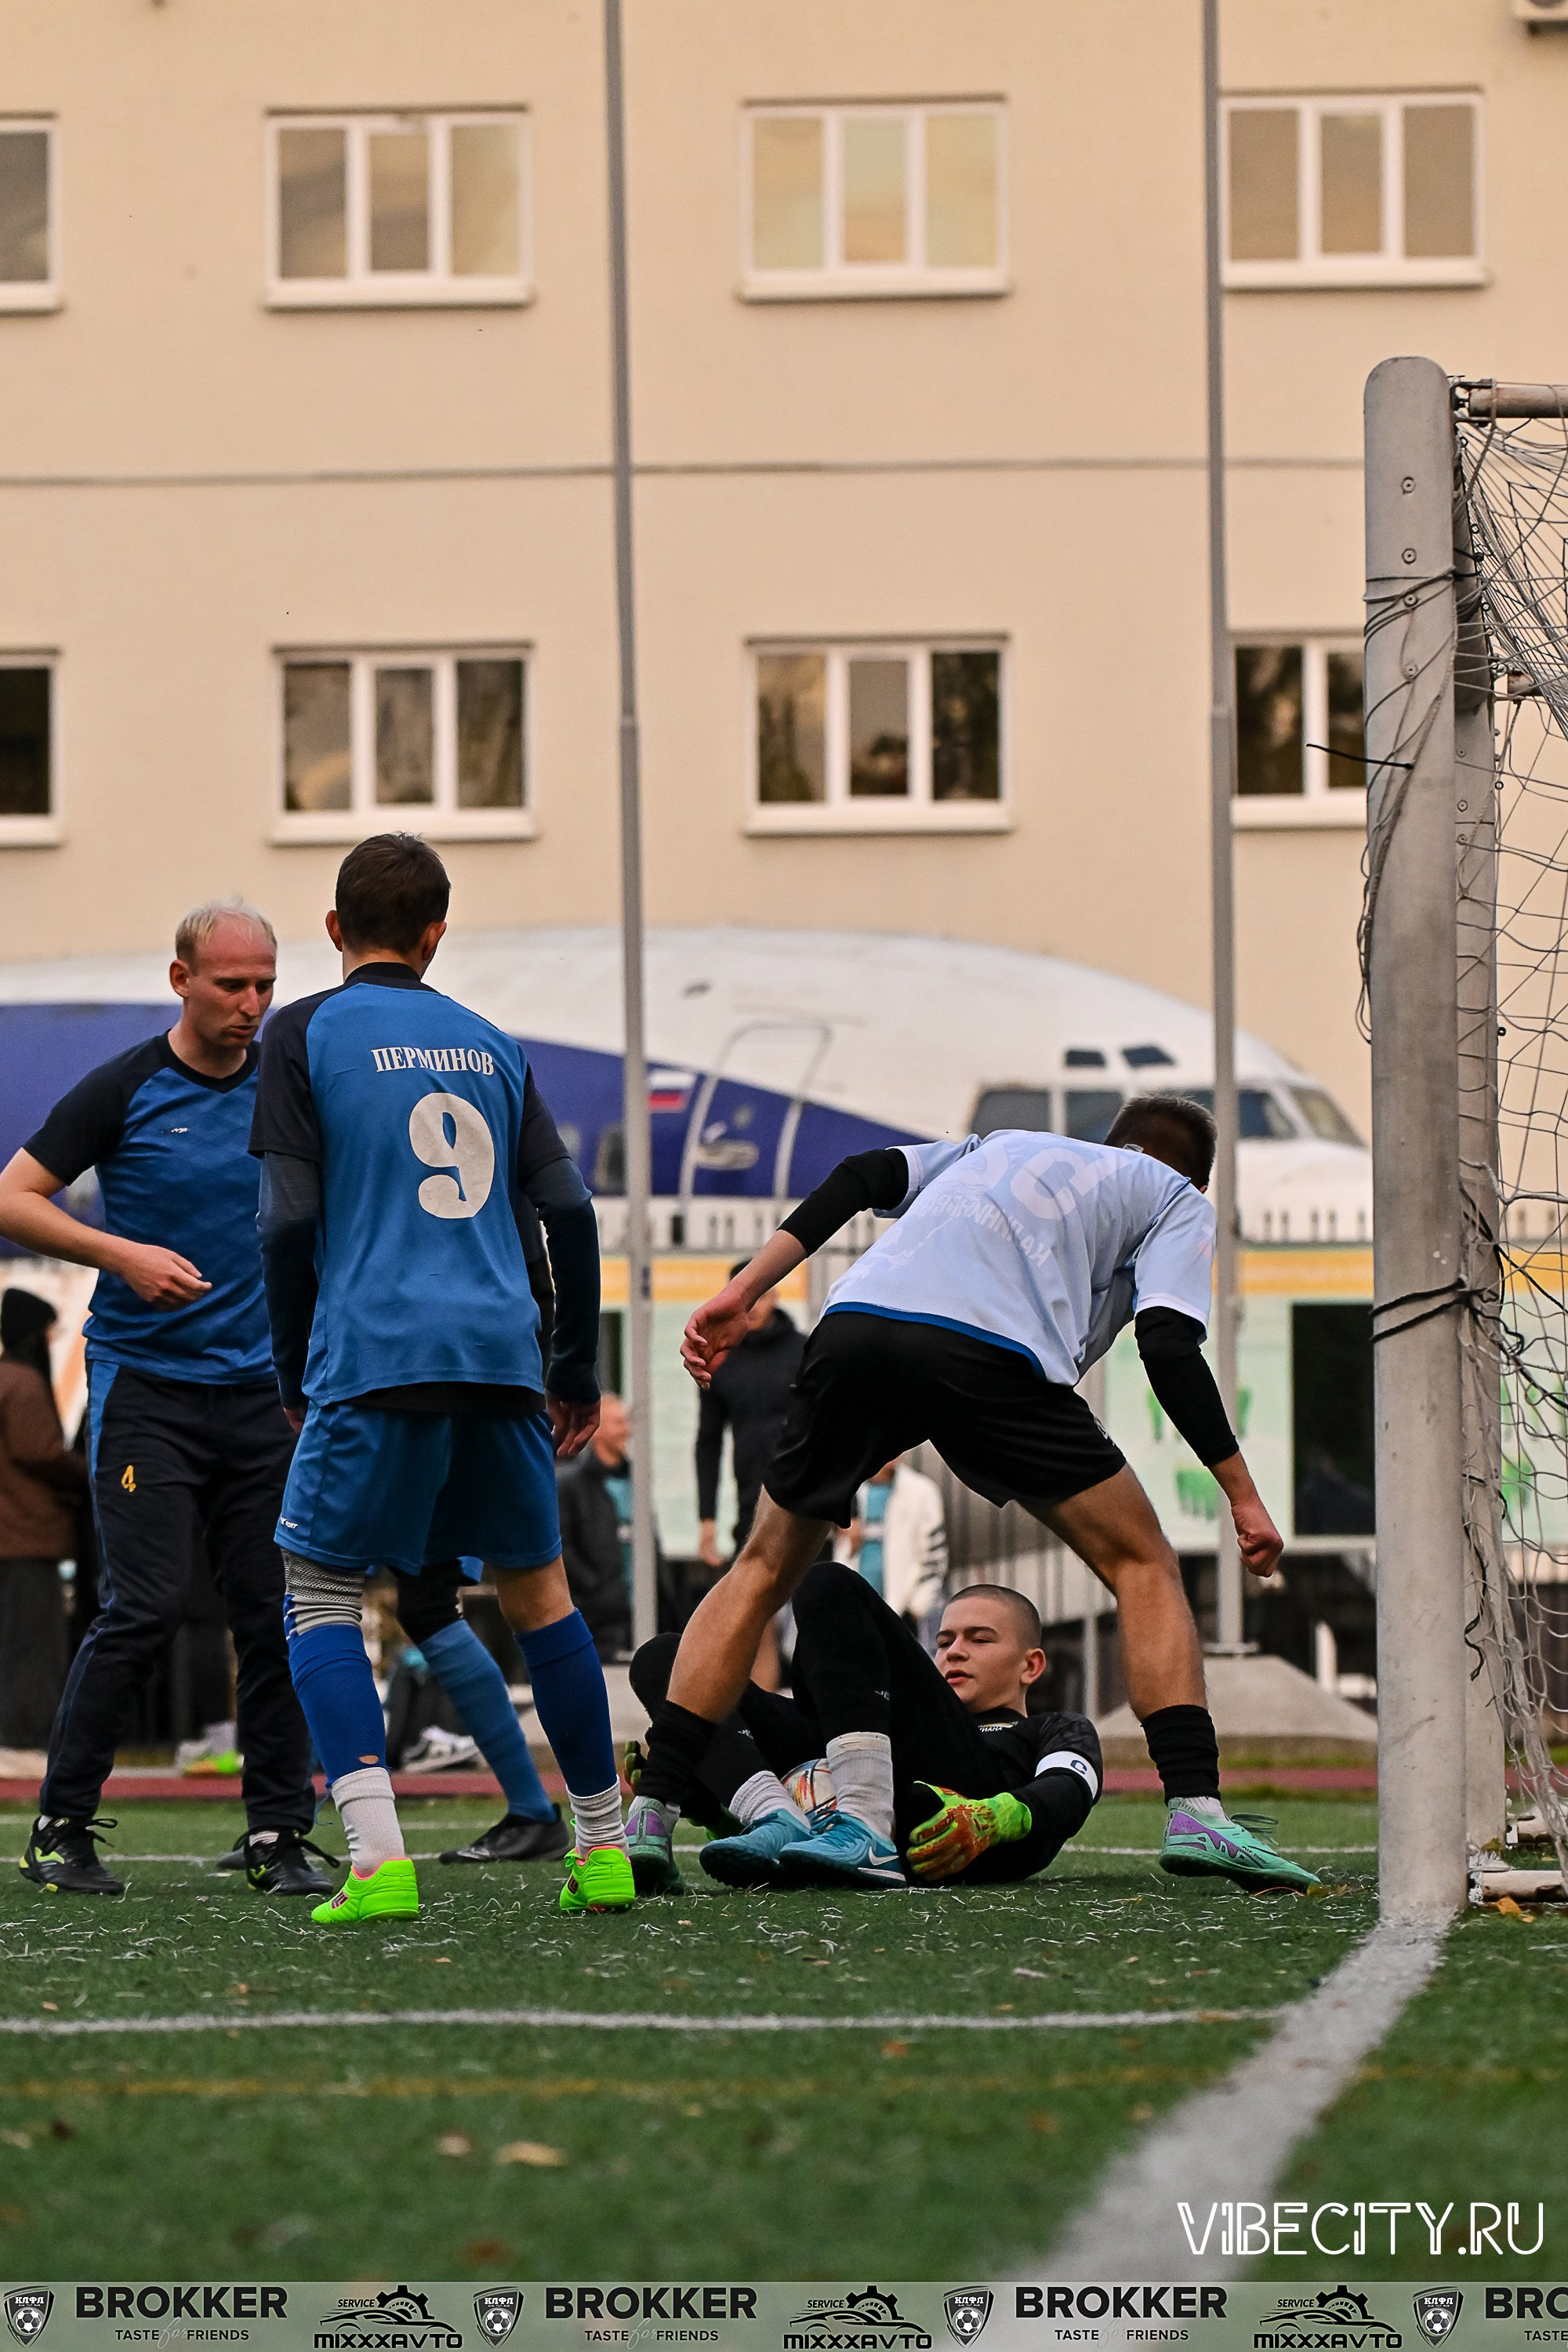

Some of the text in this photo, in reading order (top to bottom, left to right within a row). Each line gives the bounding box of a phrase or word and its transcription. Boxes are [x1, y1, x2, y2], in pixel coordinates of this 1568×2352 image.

[371, 1047, 495, 1076] ПЕРМИНОВ
[408, 1091, 495, 1219] 9
[121, 1464, 136, 1492] 4
[1070, 1759, 1087, 1775] C
